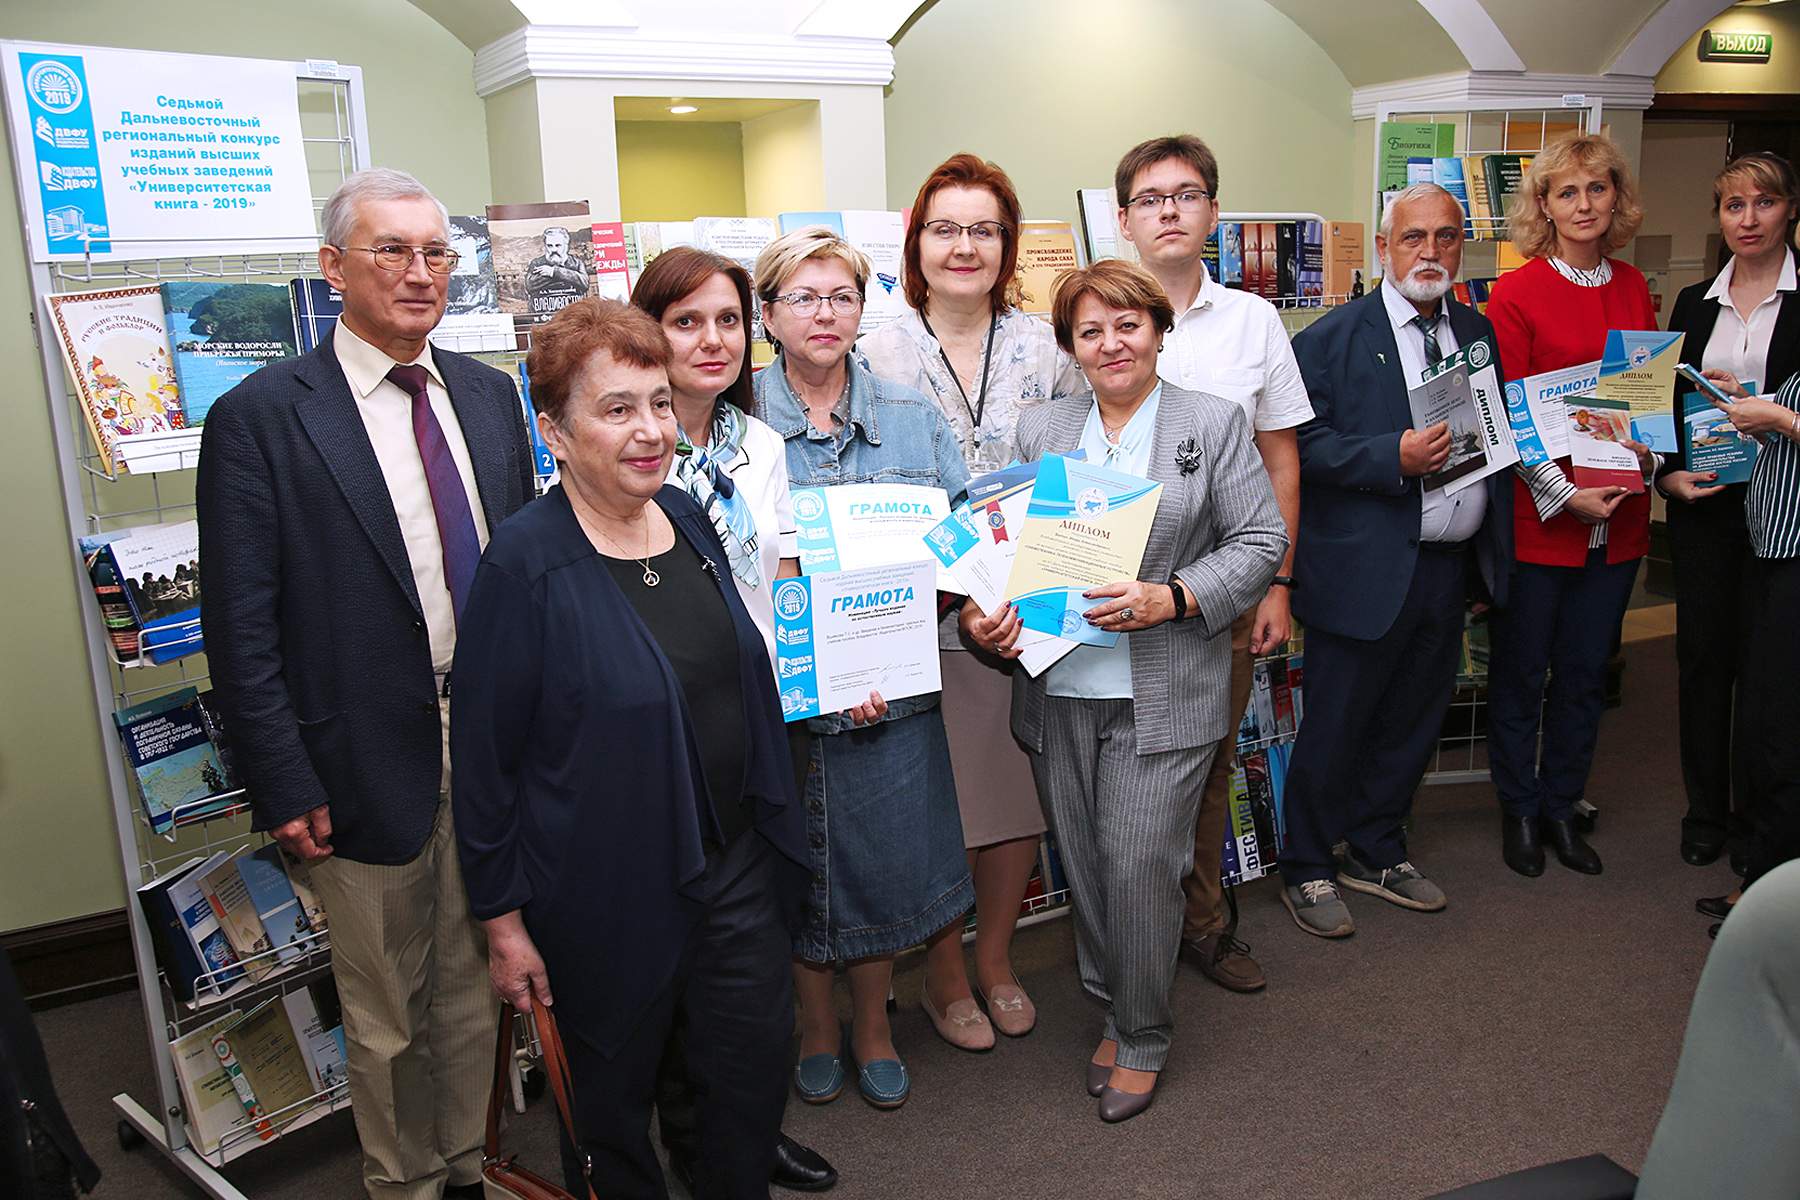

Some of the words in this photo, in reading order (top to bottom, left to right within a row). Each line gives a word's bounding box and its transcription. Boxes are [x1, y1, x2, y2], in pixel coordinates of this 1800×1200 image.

[1717, 35, 1766, 52] ВЫХОД
[45, 91, 71, 105] 2019
[156, 95, 223, 110] Седьмой
[121, 111, 261, 128] Дальневосточный
[55, 128, 88, 138] ДВФУ
[103, 129, 216, 144] региональный
[221, 133, 280, 147] конкурс
[131, 147, 196, 160] изданий
[201, 149, 260, 161] высших
[121, 164, 189, 178] учебных
[194, 164, 273, 177] заведений
[64, 178, 98, 191] ДВФУ
[129, 180, 271, 195] «Университетская
[154, 198, 199, 210] книга
[213, 197, 256, 209] 2019»
[235, 341, 282, 349] ВОДОРОСЛИ
[1540, 376, 1598, 400] ГРАМОТА
[1475, 387, 1500, 447] ДИПЛОМ
[542, 454, 552, 467] 2
[850, 502, 932, 515] ГРАМОТА
[1060, 520, 1112, 540] ДИПЛОМ
[831, 586, 914, 613] ГРАМОТА
